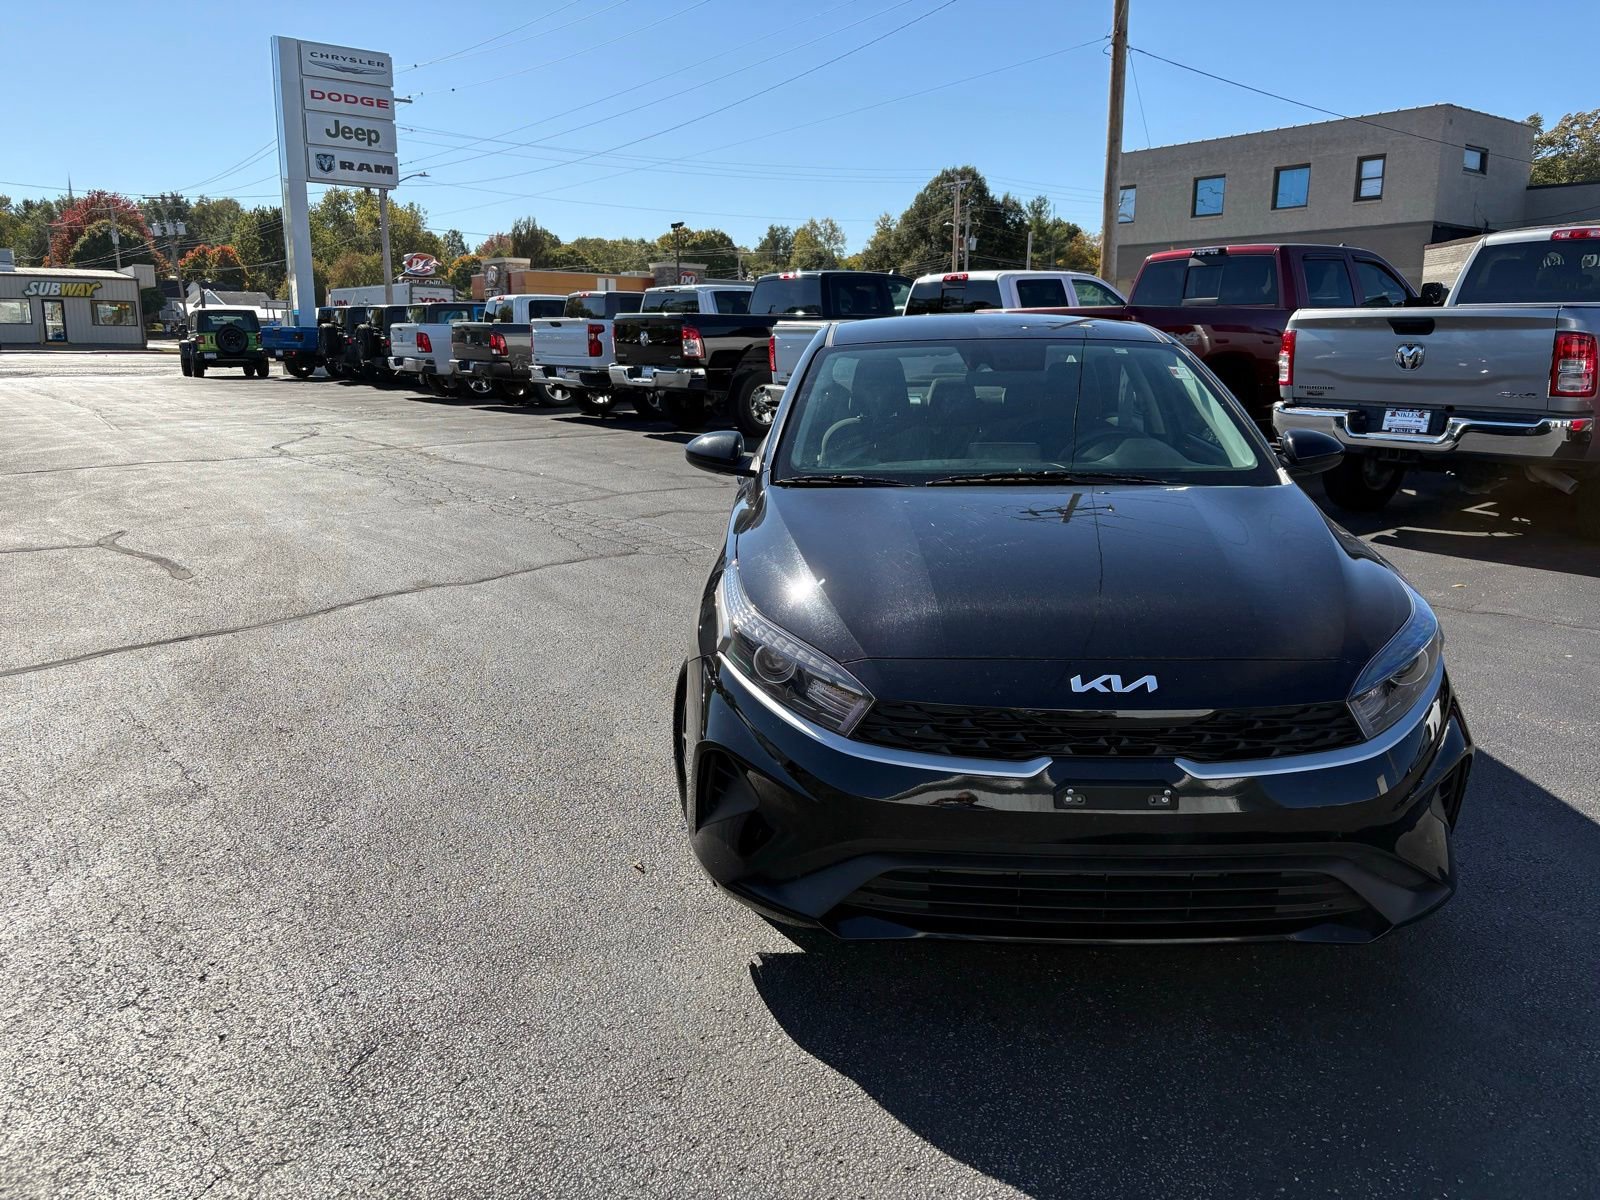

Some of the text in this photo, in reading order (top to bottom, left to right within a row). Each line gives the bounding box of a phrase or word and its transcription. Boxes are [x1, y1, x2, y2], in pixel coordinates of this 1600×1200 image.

[310, 51, 385, 68] CHRYSLER
[310, 89, 390, 109] DODGE
[325, 119, 380, 146] Jeep
[339, 160, 393, 175] RAM
[681, 275, 697, 285] DQ
[23, 281, 102, 297] SUBWAY
[1070, 674, 1158, 693] KIA
